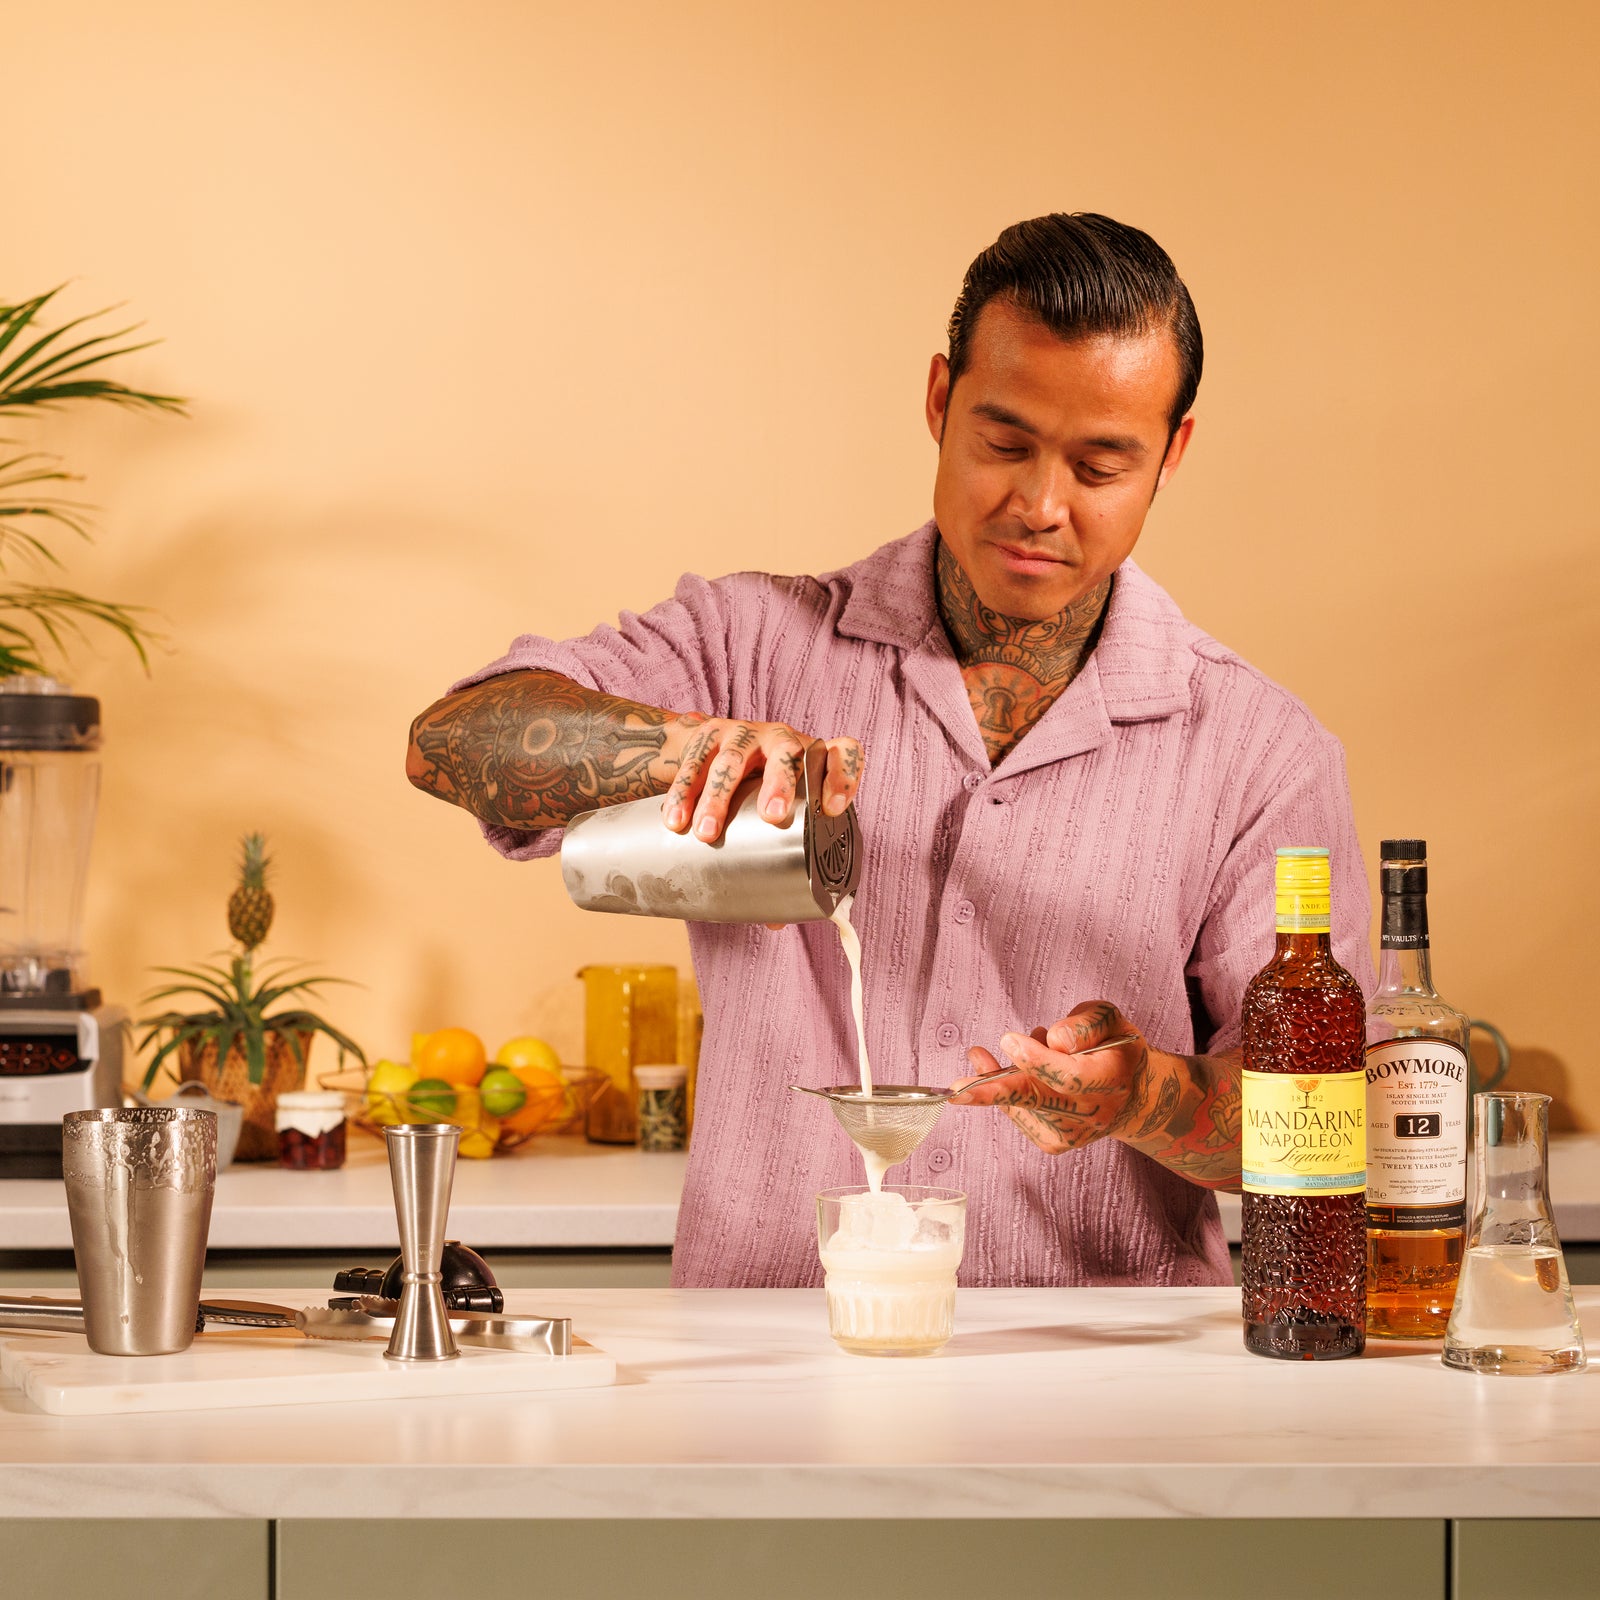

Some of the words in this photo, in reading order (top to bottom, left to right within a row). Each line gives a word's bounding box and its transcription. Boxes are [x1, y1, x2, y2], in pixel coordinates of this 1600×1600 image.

[1365, 1058, 1465, 1085] BOWMORE
[1419, 1081, 1439, 1089] 1779
[1248, 1108, 1363, 1132] MANDARINE
[1407, 1118, 1430, 1135] 12
[1260, 1130, 1353, 1148] NAPOLÉON
